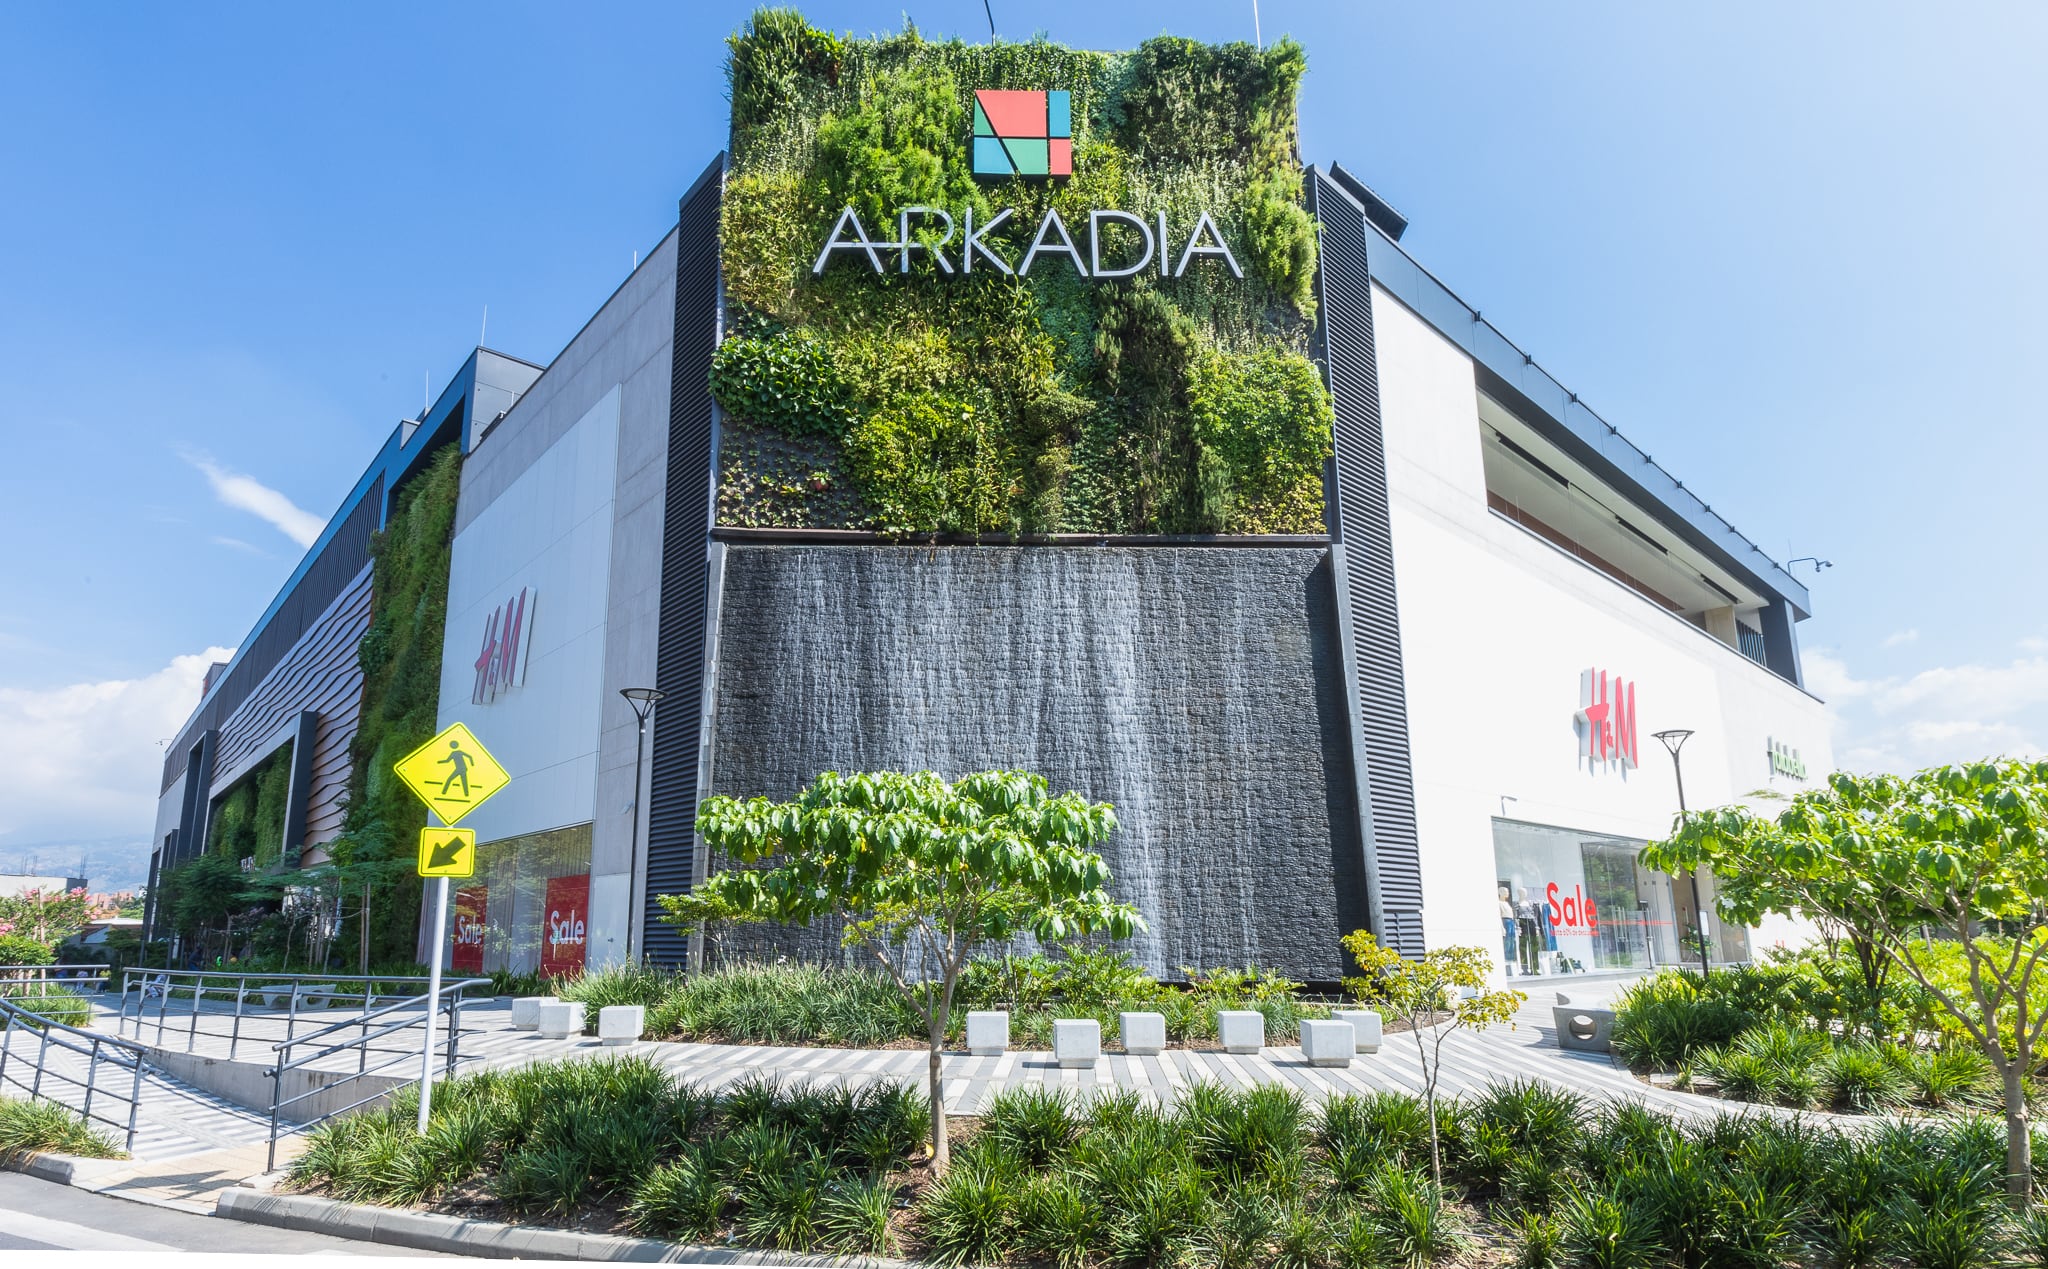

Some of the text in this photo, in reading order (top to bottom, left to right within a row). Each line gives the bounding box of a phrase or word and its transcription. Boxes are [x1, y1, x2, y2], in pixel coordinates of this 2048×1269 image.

[813, 205, 1244, 279] ARKADIA
[472, 586, 532, 705] H&M
[1582, 666, 1638, 769] H&M
[457, 914, 483, 944] Sale
[548, 909, 585, 945] Sale
[1546, 882, 1597, 927] Sale
